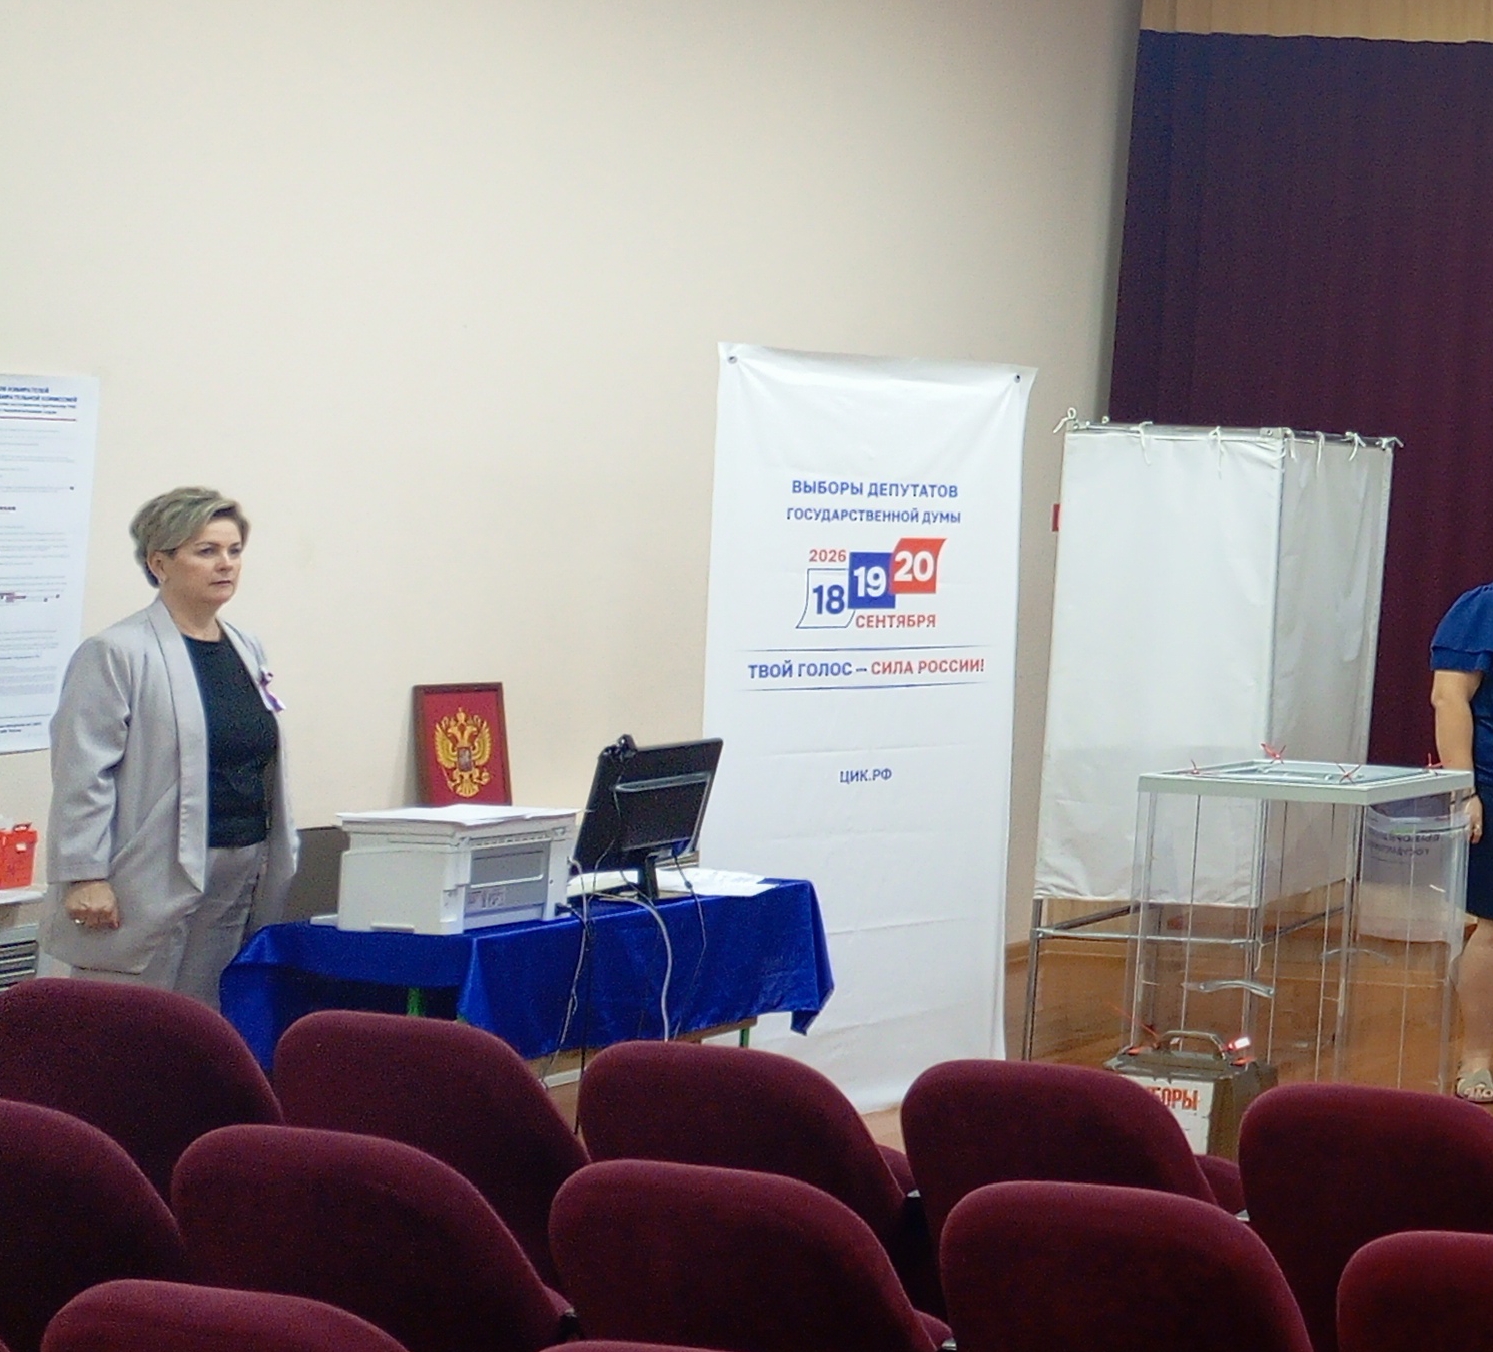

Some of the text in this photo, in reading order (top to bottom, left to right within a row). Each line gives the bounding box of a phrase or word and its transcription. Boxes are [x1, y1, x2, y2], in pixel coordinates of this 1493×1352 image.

[792, 480, 958, 498] ВЫБОРЫ ДЕПУТАТОВ
[787, 508, 961, 525] ГОСУДАРСТВЕННОЙ ДУМЫ
[809, 549, 846, 562] 2026
[813, 551, 934, 615] 18 19 20
[856, 614, 936, 628] СЕНТЯБРЯ
[748, 660, 793, 679] ТВОЙ
[797, 662, 852, 678] ГОЛОС
[871, 661, 913, 675] СИЛА
[918, 659, 984, 675] РОССИИ!
[839, 768, 892, 784] ЦИК.РФ
